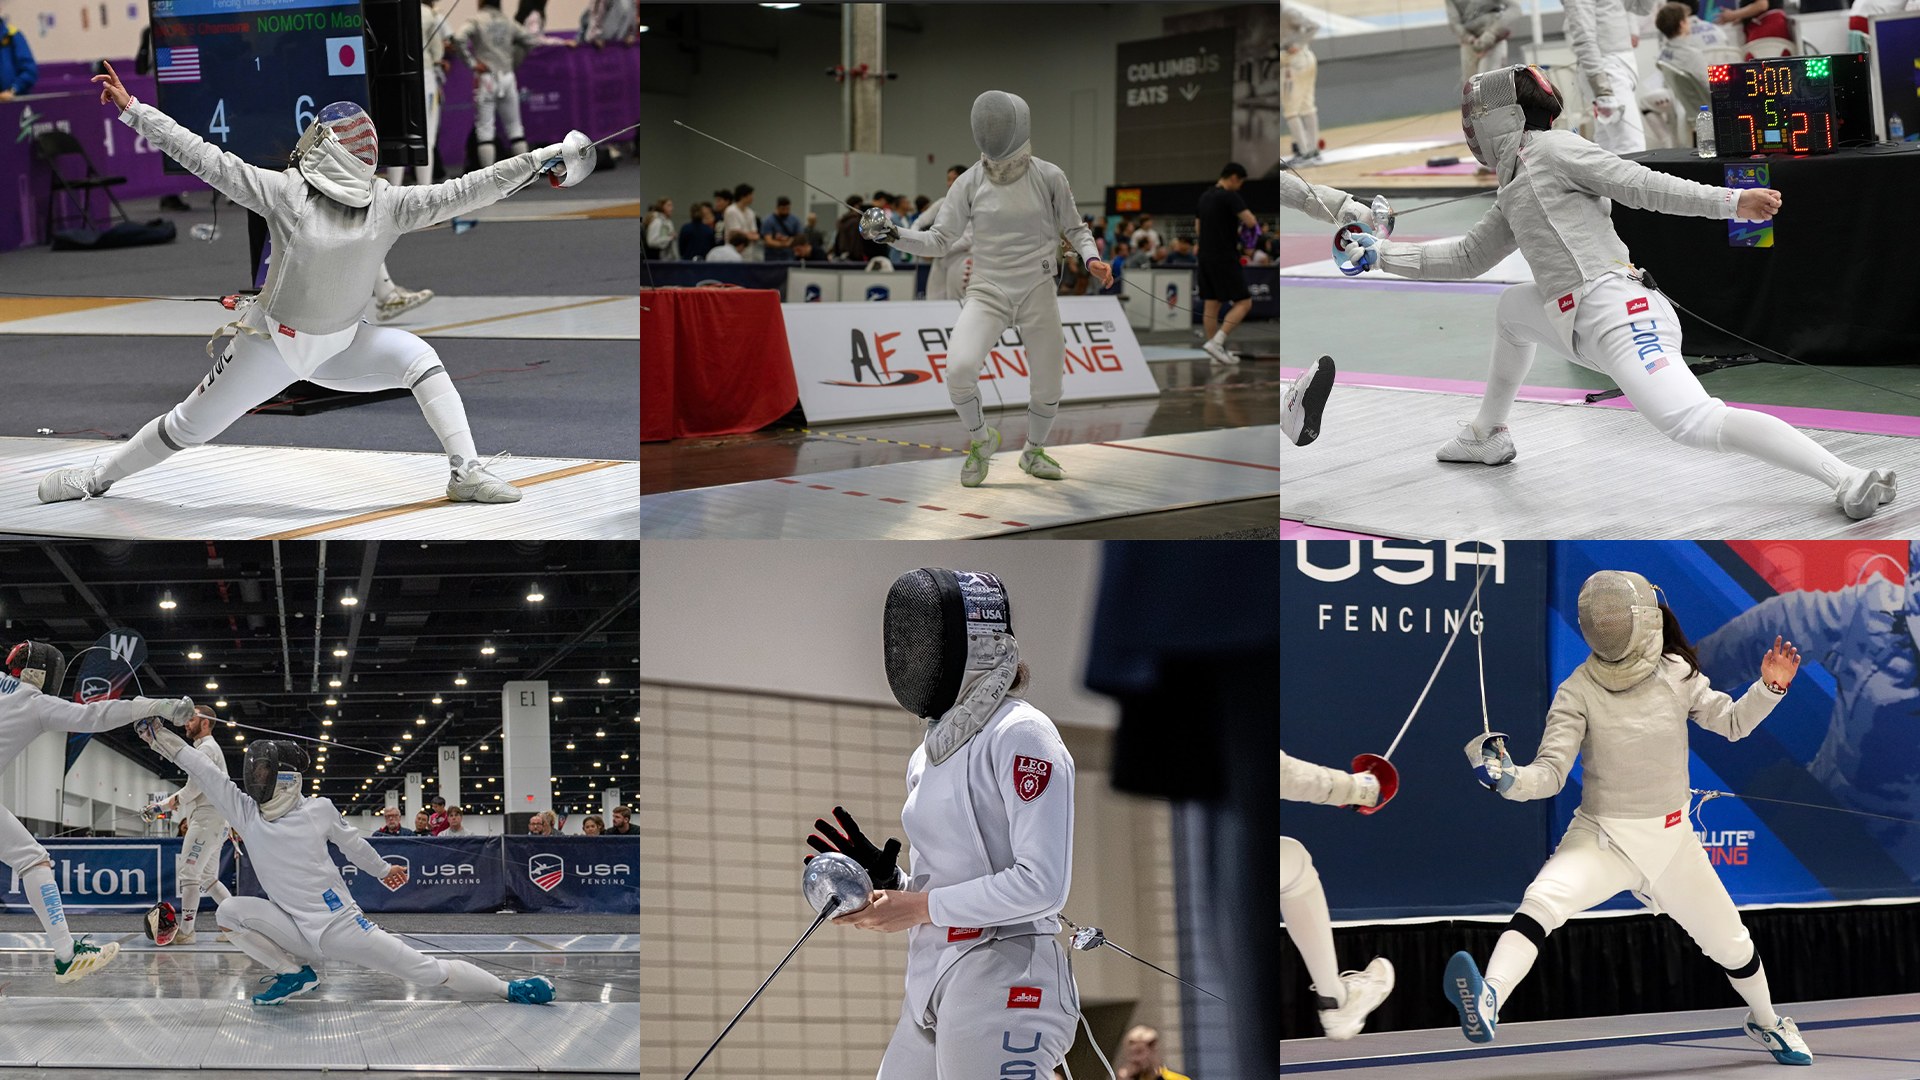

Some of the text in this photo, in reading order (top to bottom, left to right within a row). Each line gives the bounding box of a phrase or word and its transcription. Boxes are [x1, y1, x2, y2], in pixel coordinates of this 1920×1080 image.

[257, 12, 361, 33] NOMOTO Mao
[255, 57, 260, 71] 1
[1127, 53, 1221, 82] COLUMBUS
[1746, 67, 1792, 97] 3:00
[1127, 85, 1168, 106] EATS
[209, 98, 230, 143] 4
[295, 95, 315, 137] 6
[1738, 115, 1756, 151] 7
[1791, 112, 1832, 152] 21
[1296, 540, 1505, 585] USA
[982, 609, 1003, 620] USA
[1319, 604, 1484, 635] FENCING
[110, 633, 138, 662] W
[520, 691, 537, 707] E1
[443, 751, 456, 761] D4
[1020, 757, 1048, 771] LEO
[409, 775, 419, 784] D1
[422, 864, 474, 876] USA
[575, 864, 630, 876] USA
[1455, 977, 1484, 1036] Kempa
